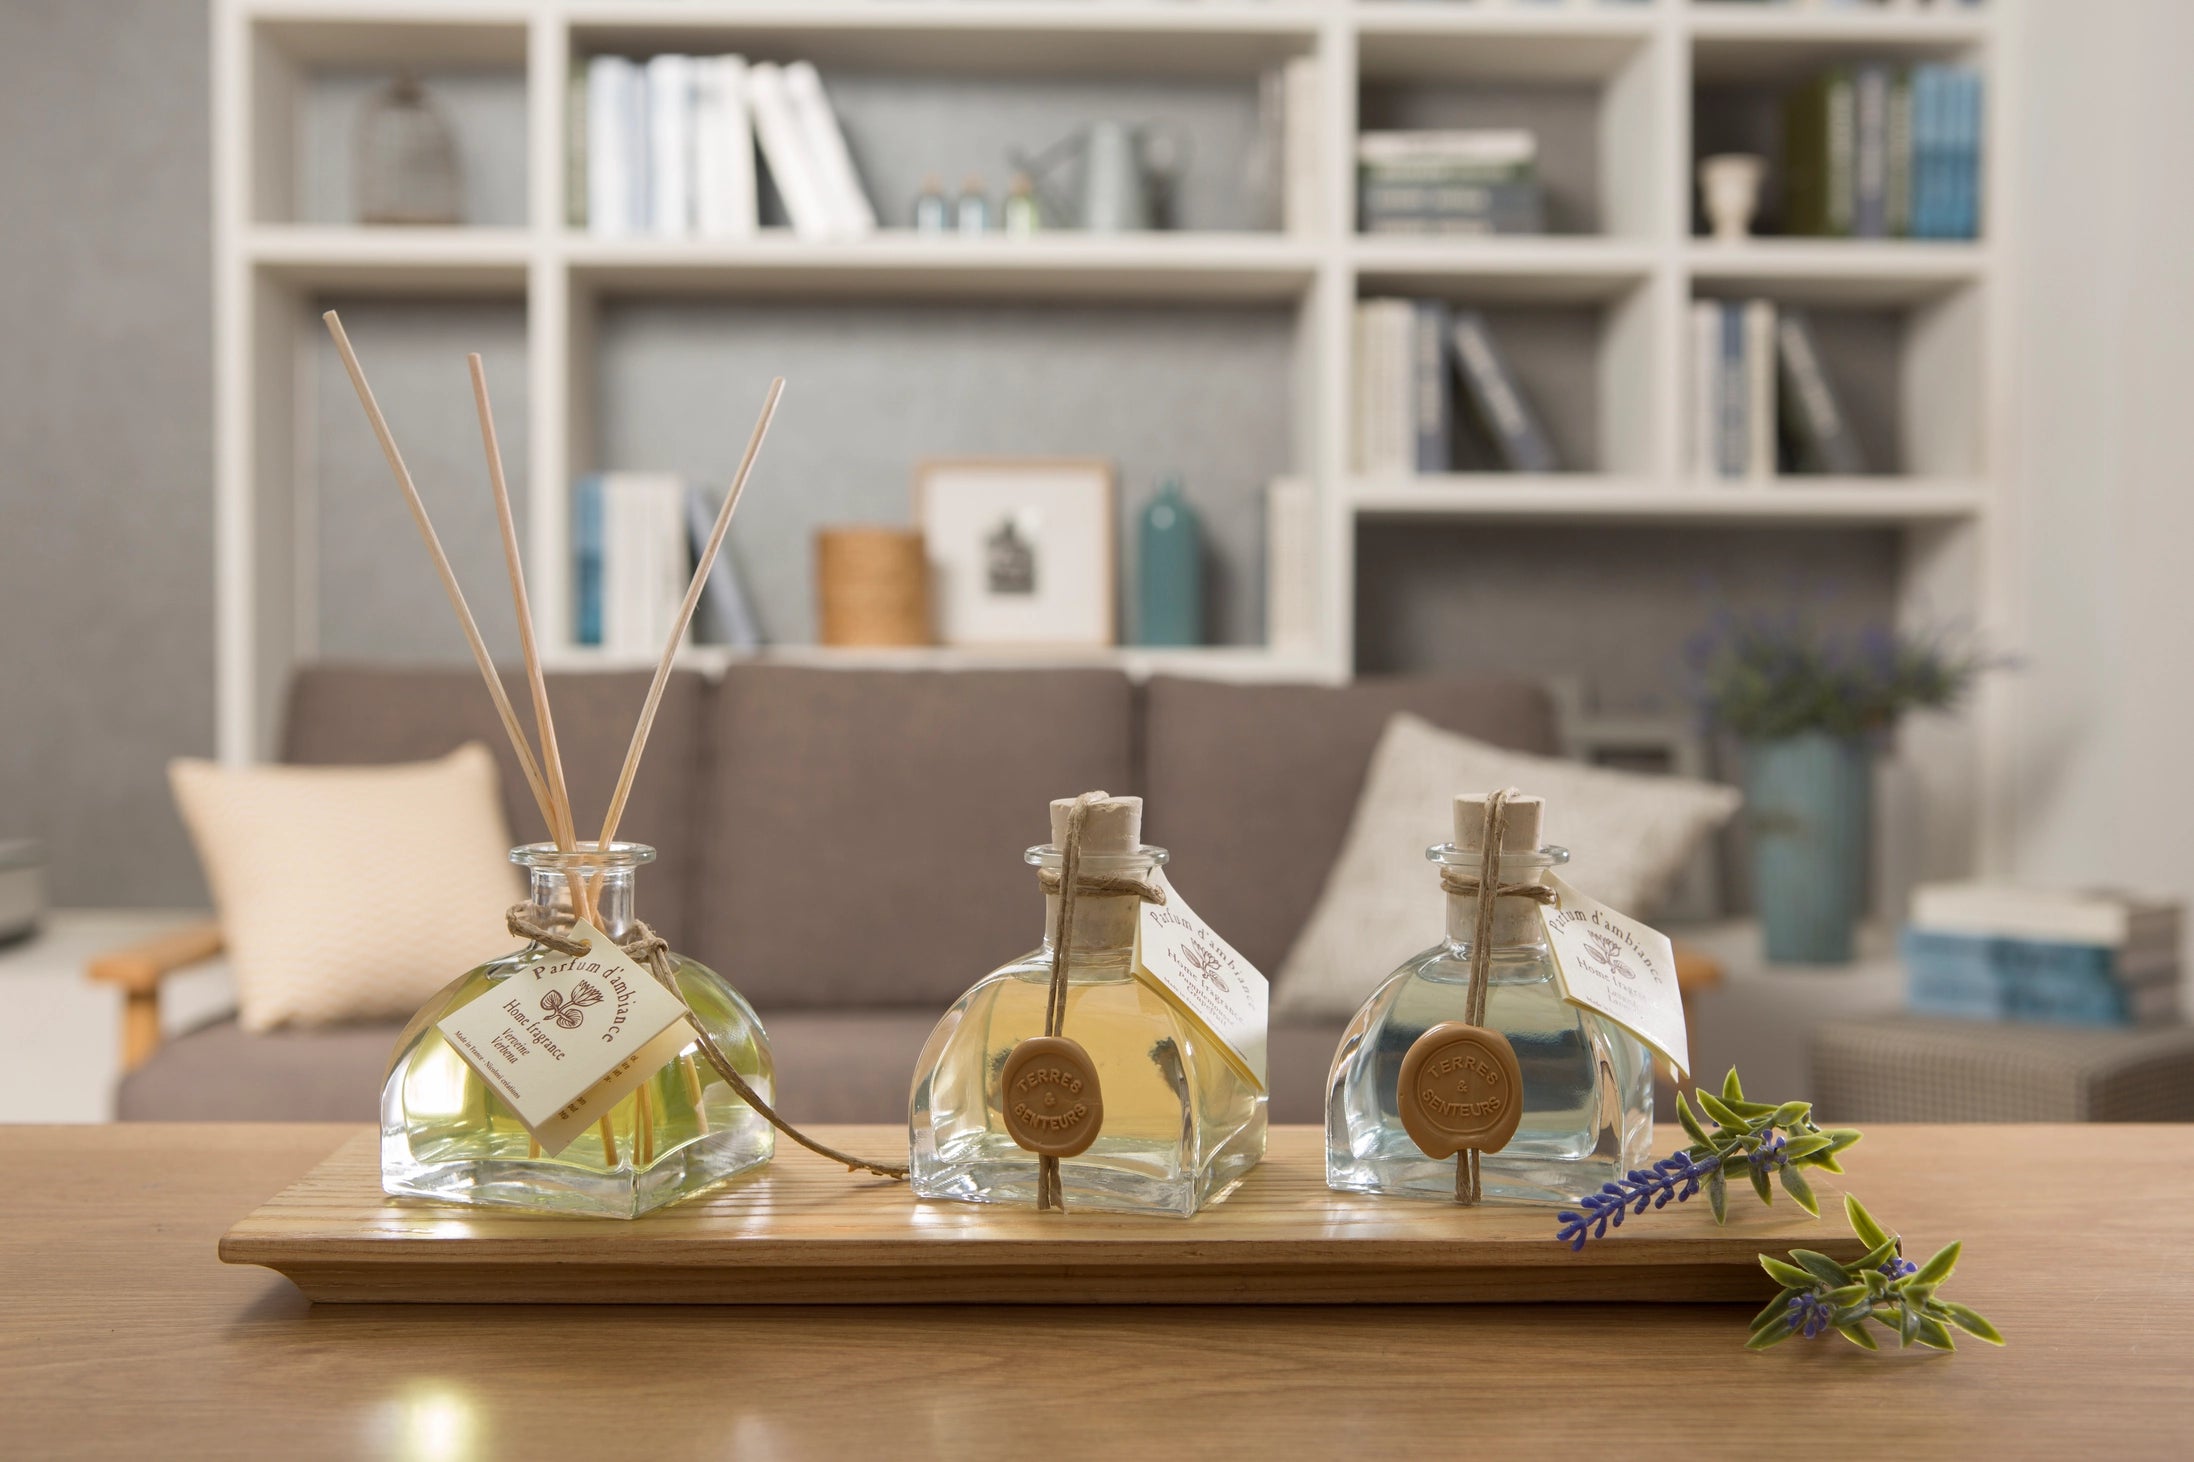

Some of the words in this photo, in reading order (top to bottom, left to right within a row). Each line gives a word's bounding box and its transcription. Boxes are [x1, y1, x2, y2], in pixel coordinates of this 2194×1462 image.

[1150, 907, 1193, 931] Parfum
[1549, 910, 1587, 935] Parfum
[1591, 910, 1662, 984] d'ambiance
[1167, 948, 1198, 982] Home
[1577, 956, 1610, 982] Home
[532, 958, 602, 981] Parfum
[602, 967, 637, 1043] d'ambiance
[502, 998, 530, 1026] Home
[526, 1021, 565, 1061] fragrance
[502, 1027, 530, 1056] Verveine
[455, 1030, 467, 1043] Made
[470, 1044, 484, 1061] France
[491, 1036, 519, 1064] Verbena
[1016, 1068, 1083, 1093] TERRES
[1427, 1055, 1499, 1085] TERRES
[1457, 1080, 1468, 1092] &
[1014, 1103, 1088, 1131] SENTEURS
[1423, 1088, 1501, 1117] SENTEURS
